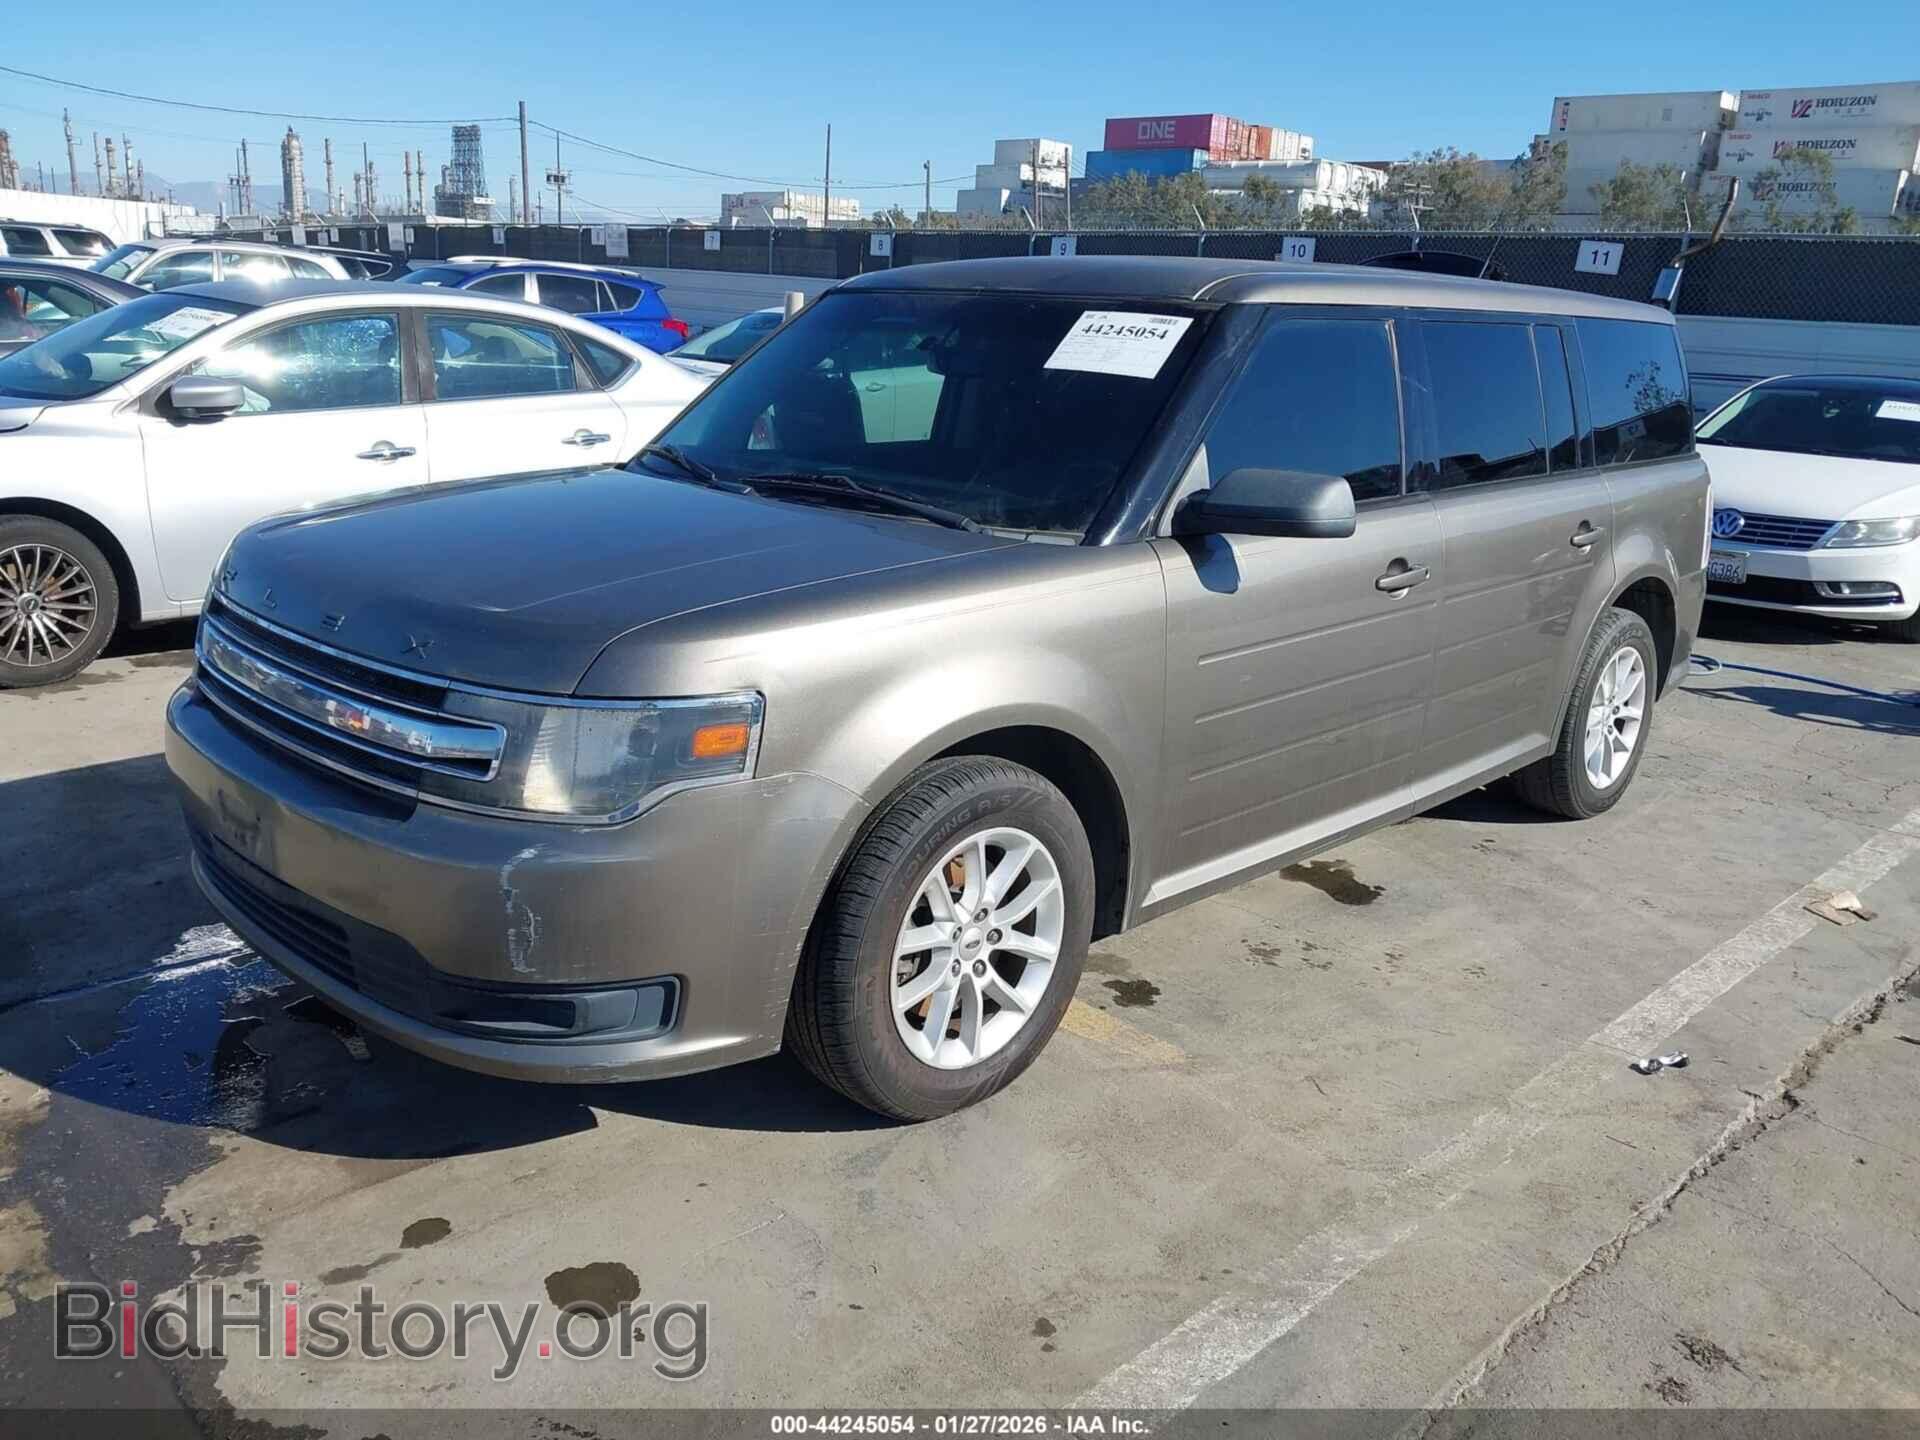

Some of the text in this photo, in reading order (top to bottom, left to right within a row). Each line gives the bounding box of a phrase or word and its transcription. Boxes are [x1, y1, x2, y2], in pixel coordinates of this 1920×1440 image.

[1815, 95, 1878, 108] HORIZON
[1137, 120, 1176, 140] ONE
[1796, 138, 1857, 149] HORIZON
[1060, 242, 1068, 256] 9
[1290, 243, 1306, 258] 10
[1591, 249, 1611, 266] 11
[1082, 323, 1169, 340] 44245054
[1707, 561, 1741, 579] G386
